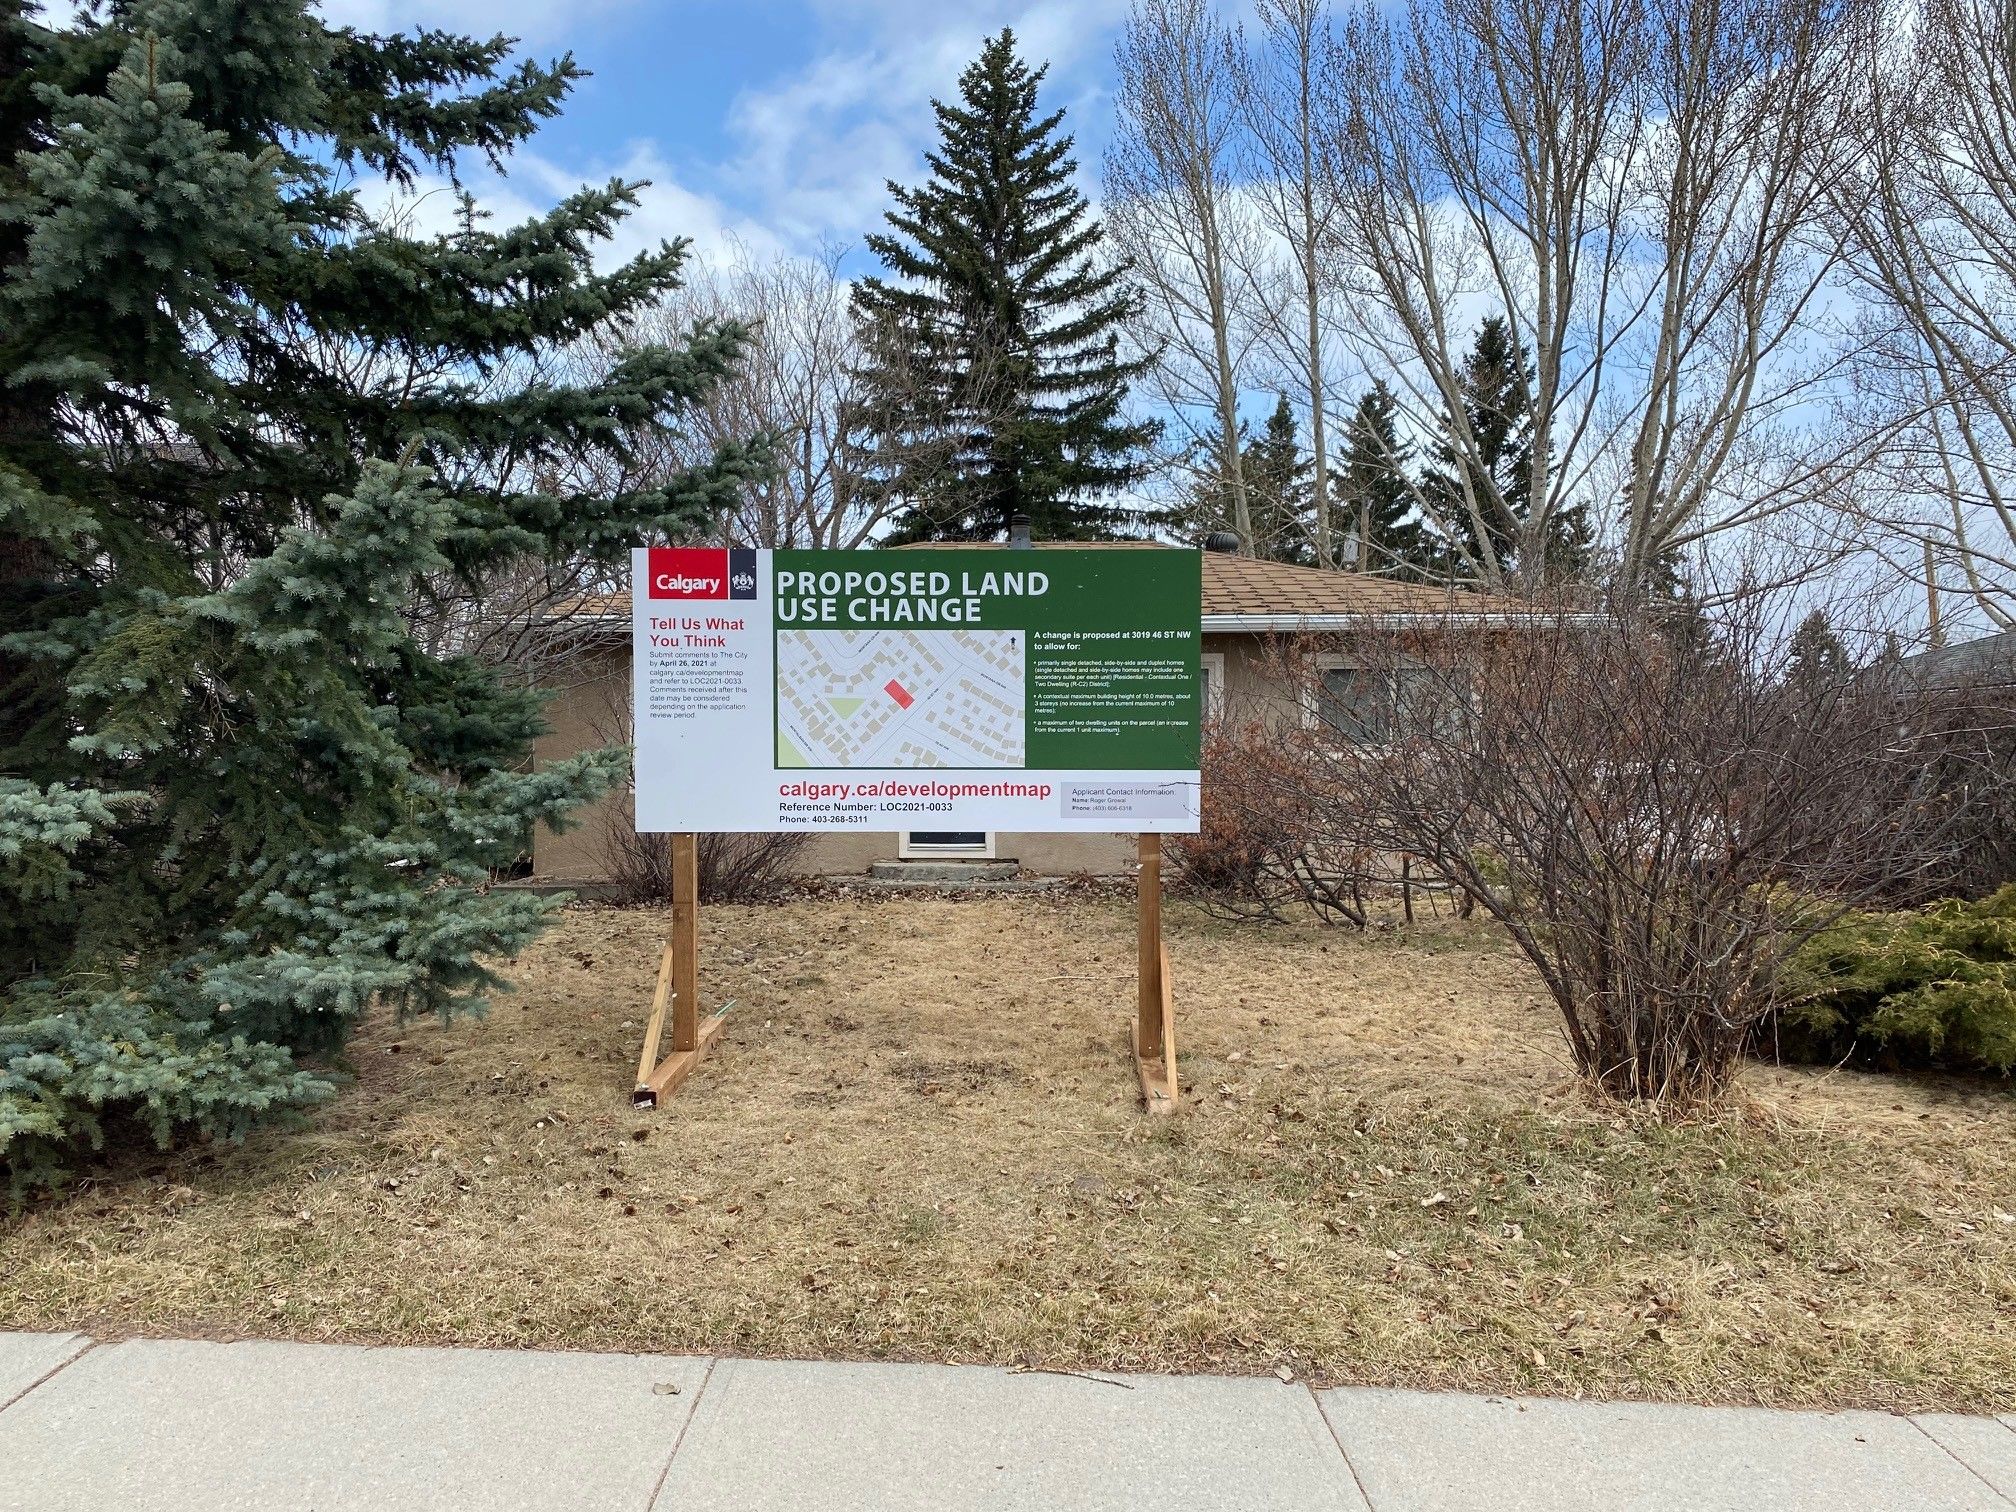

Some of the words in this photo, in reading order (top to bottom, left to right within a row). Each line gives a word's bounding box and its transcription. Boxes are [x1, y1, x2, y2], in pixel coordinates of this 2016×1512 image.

[656, 574, 720, 594] Calgary
[777, 571, 951, 596] PROPOSED
[962, 571, 1049, 596] LAND
[777, 598, 837, 622] USE
[848, 598, 982, 622] CHANGE
[650, 618, 676, 630] Tell
[682, 618, 701, 630] Us
[706, 618, 744, 630] What
[650, 635, 679, 647] You
[684, 635, 726, 647] Think
[1034, 631, 1040, 639] A
[1074, 631, 1080, 639] is
[1122, 631, 1130, 639] at
[1132, 631, 1150, 639] 3019
[1152, 631, 1162, 639] 46
[1164, 631, 1174, 639] ST
[1176, 631, 1191, 639] NW
[734, 651, 748, 659] City
[779, 781, 1051, 800] calgary.ca/developmentmap
[1072, 788, 1104, 796] Applicant
[779, 803, 831, 812] Reference
[834, 803, 877, 812] Number:
[880, 803, 953, 812] LOC2021-0033
[779, 815, 810, 823] Phone:
[812, 815, 868, 823] 403-268-5311
